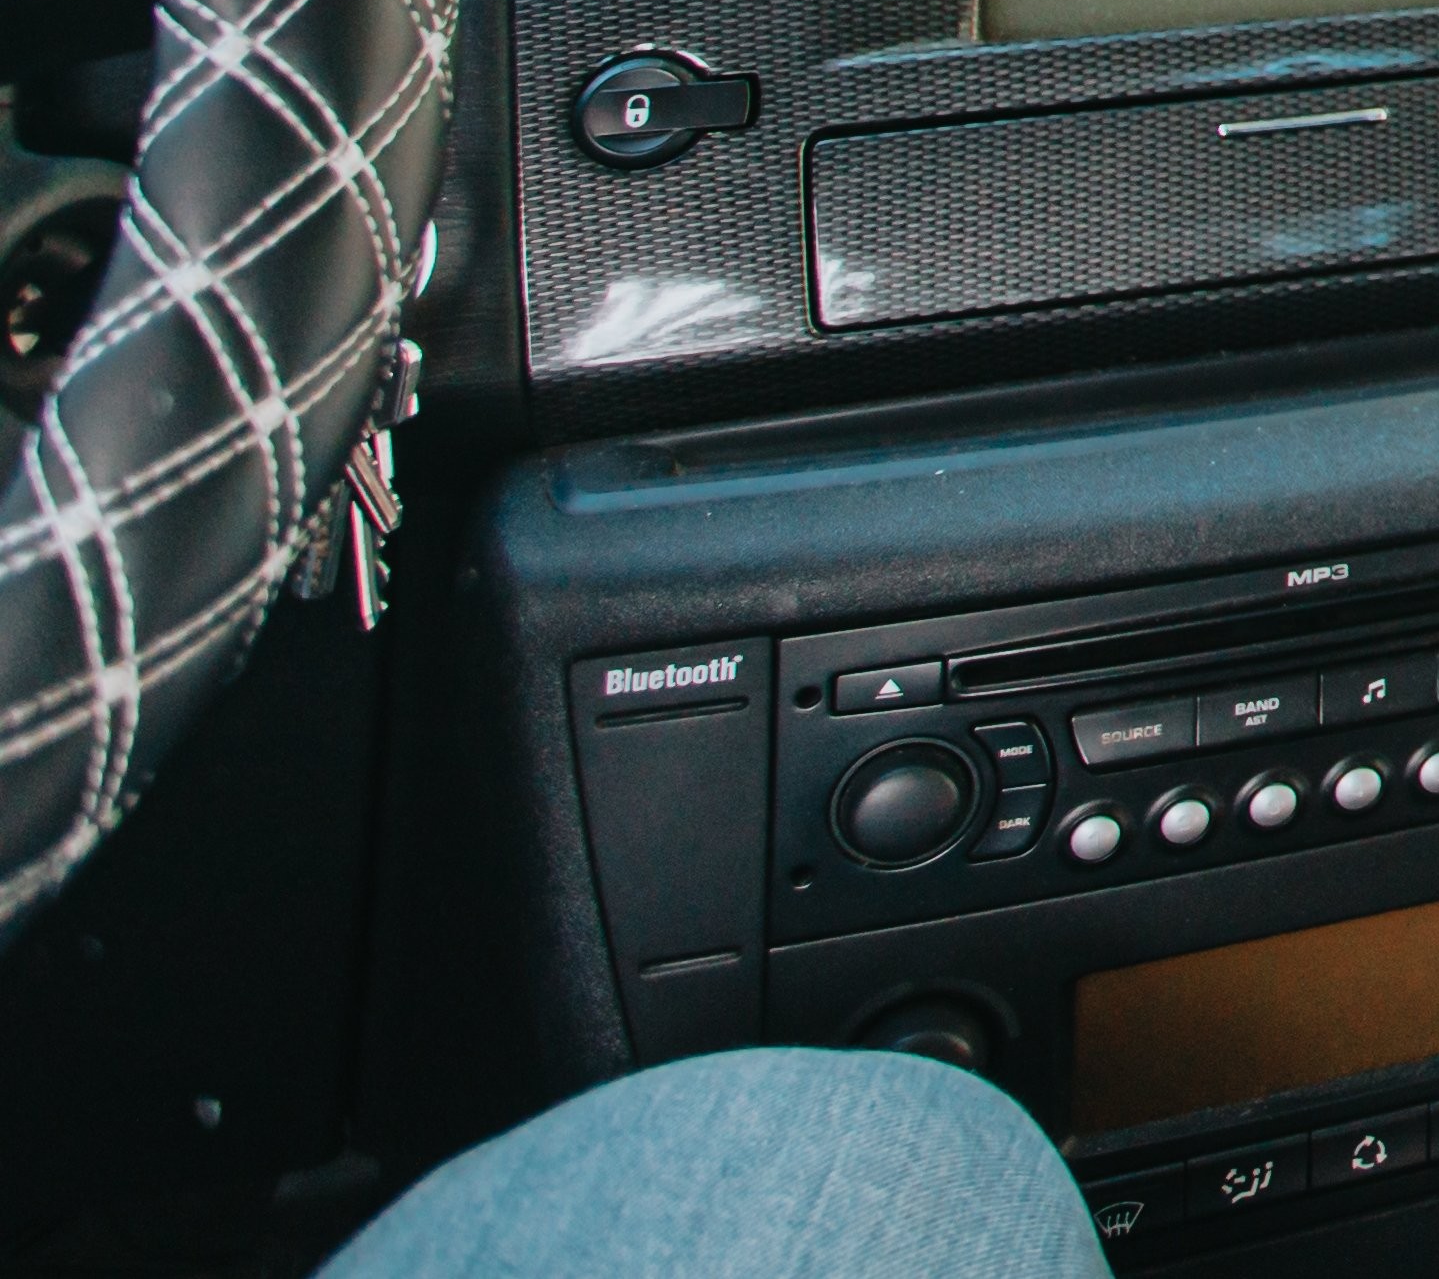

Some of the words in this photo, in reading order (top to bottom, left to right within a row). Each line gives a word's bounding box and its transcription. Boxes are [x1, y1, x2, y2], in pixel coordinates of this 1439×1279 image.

[1287, 564, 1350, 587] MP3
[1234, 697, 1280, 716] BAND
[1100, 723, 1163, 745] SOURCE
[999, 744, 1034, 758] MODE
[998, 816, 1032, 831] DARK
